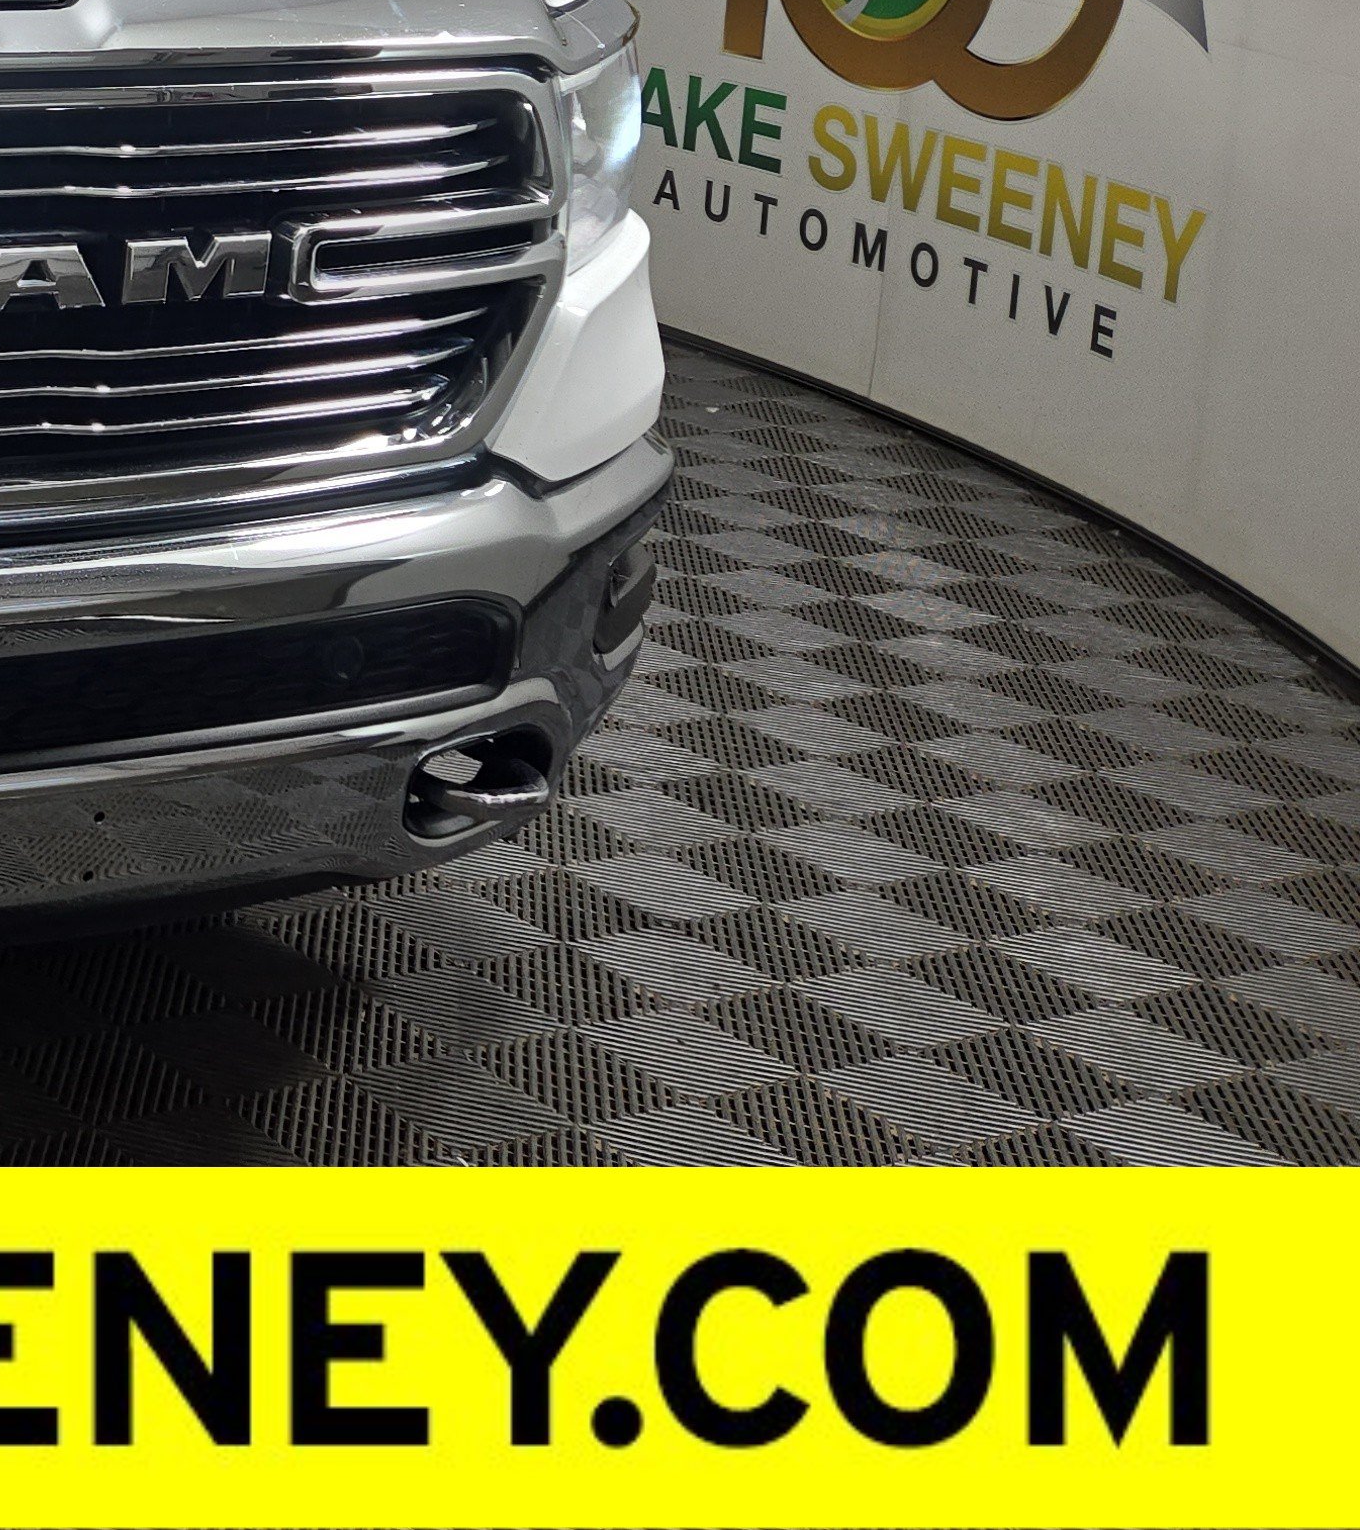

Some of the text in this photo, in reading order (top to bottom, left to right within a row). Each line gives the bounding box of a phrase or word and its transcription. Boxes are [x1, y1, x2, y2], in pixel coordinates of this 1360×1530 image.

[641, 66, 1207, 303] AKE SWEENEY
[652, 169, 1118, 359] AUTOMOTIVE
